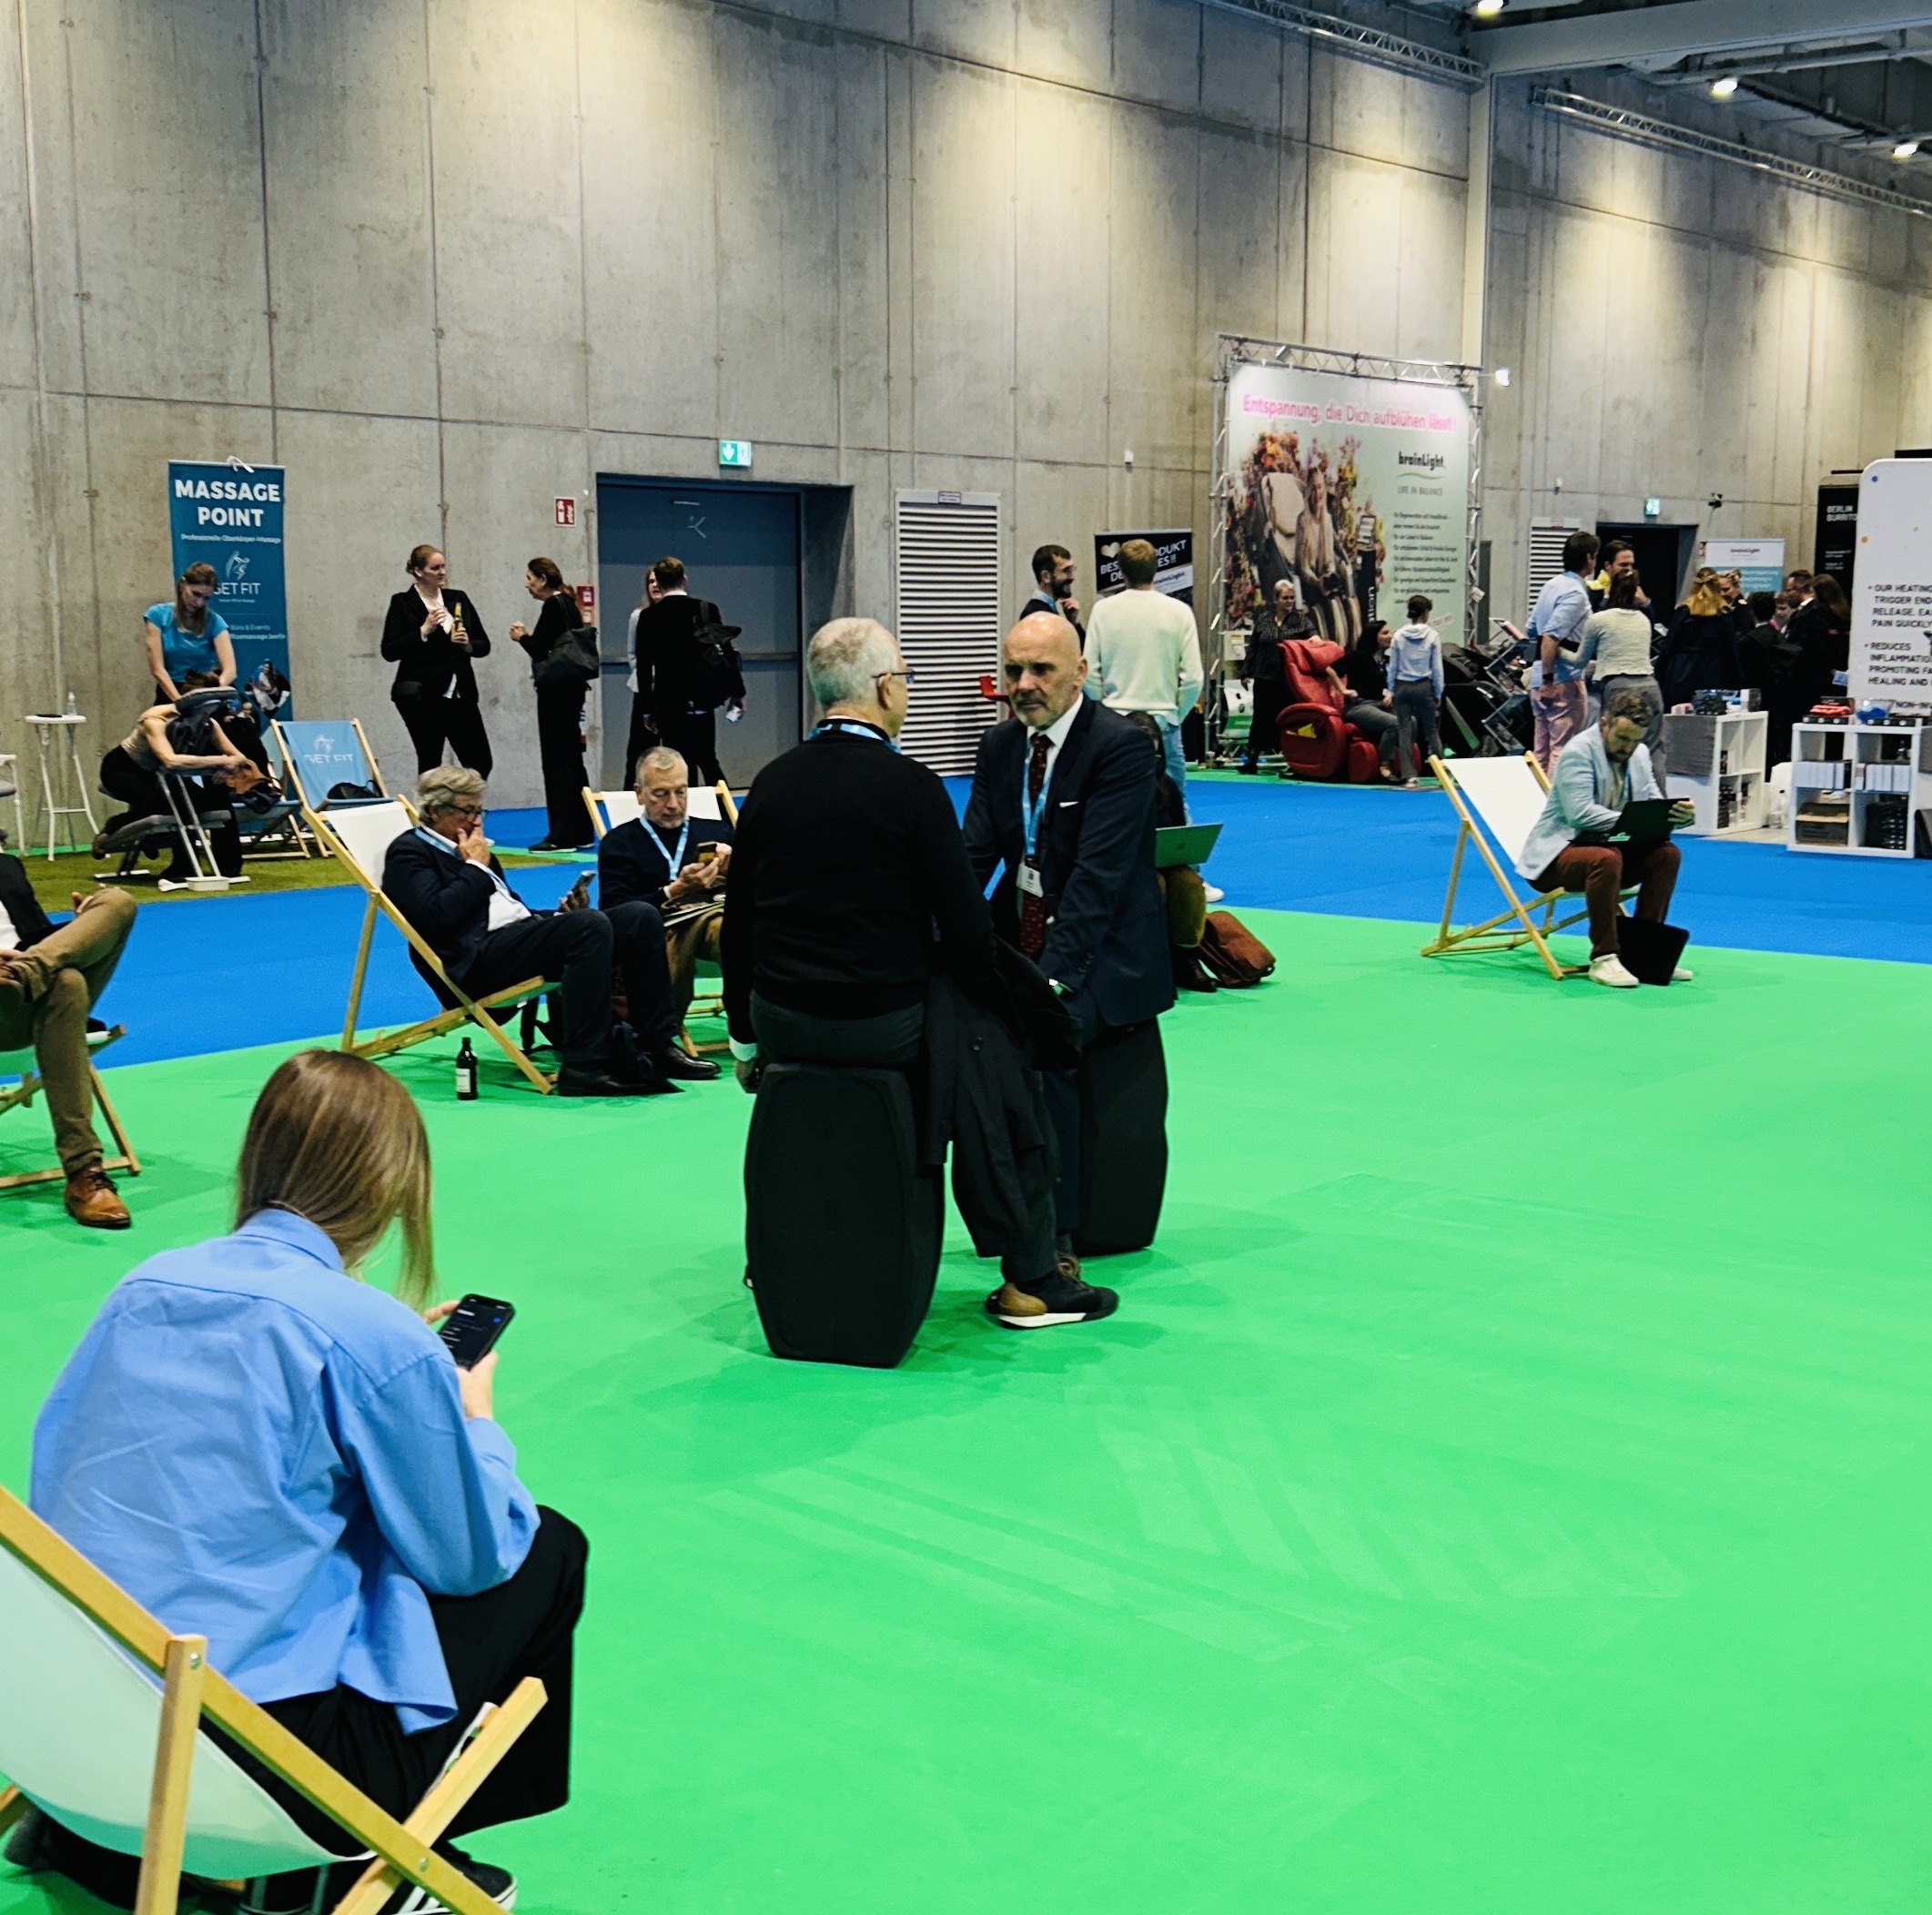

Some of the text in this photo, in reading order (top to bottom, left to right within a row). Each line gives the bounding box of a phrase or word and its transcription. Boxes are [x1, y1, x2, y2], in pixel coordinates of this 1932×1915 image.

[1326, 401, 1342, 420] die
[1347, 405, 1370, 422] Dich
[175, 480, 280, 502] MASSAGE
[197, 506, 264, 526] POINT
[1100, 540, 1187, 575] BES DUKT
[241, 583, 261, 594] FIT
[1870, 643, 1911, 651] REDUCES
[1870, 654, 1932, 663] INFLAMMATIO
[1868, 665, 1920, 674] PROMOTING
[1868, 677, 1928, 686] HEALING AND
[333, 754, 353, 762] FIT
